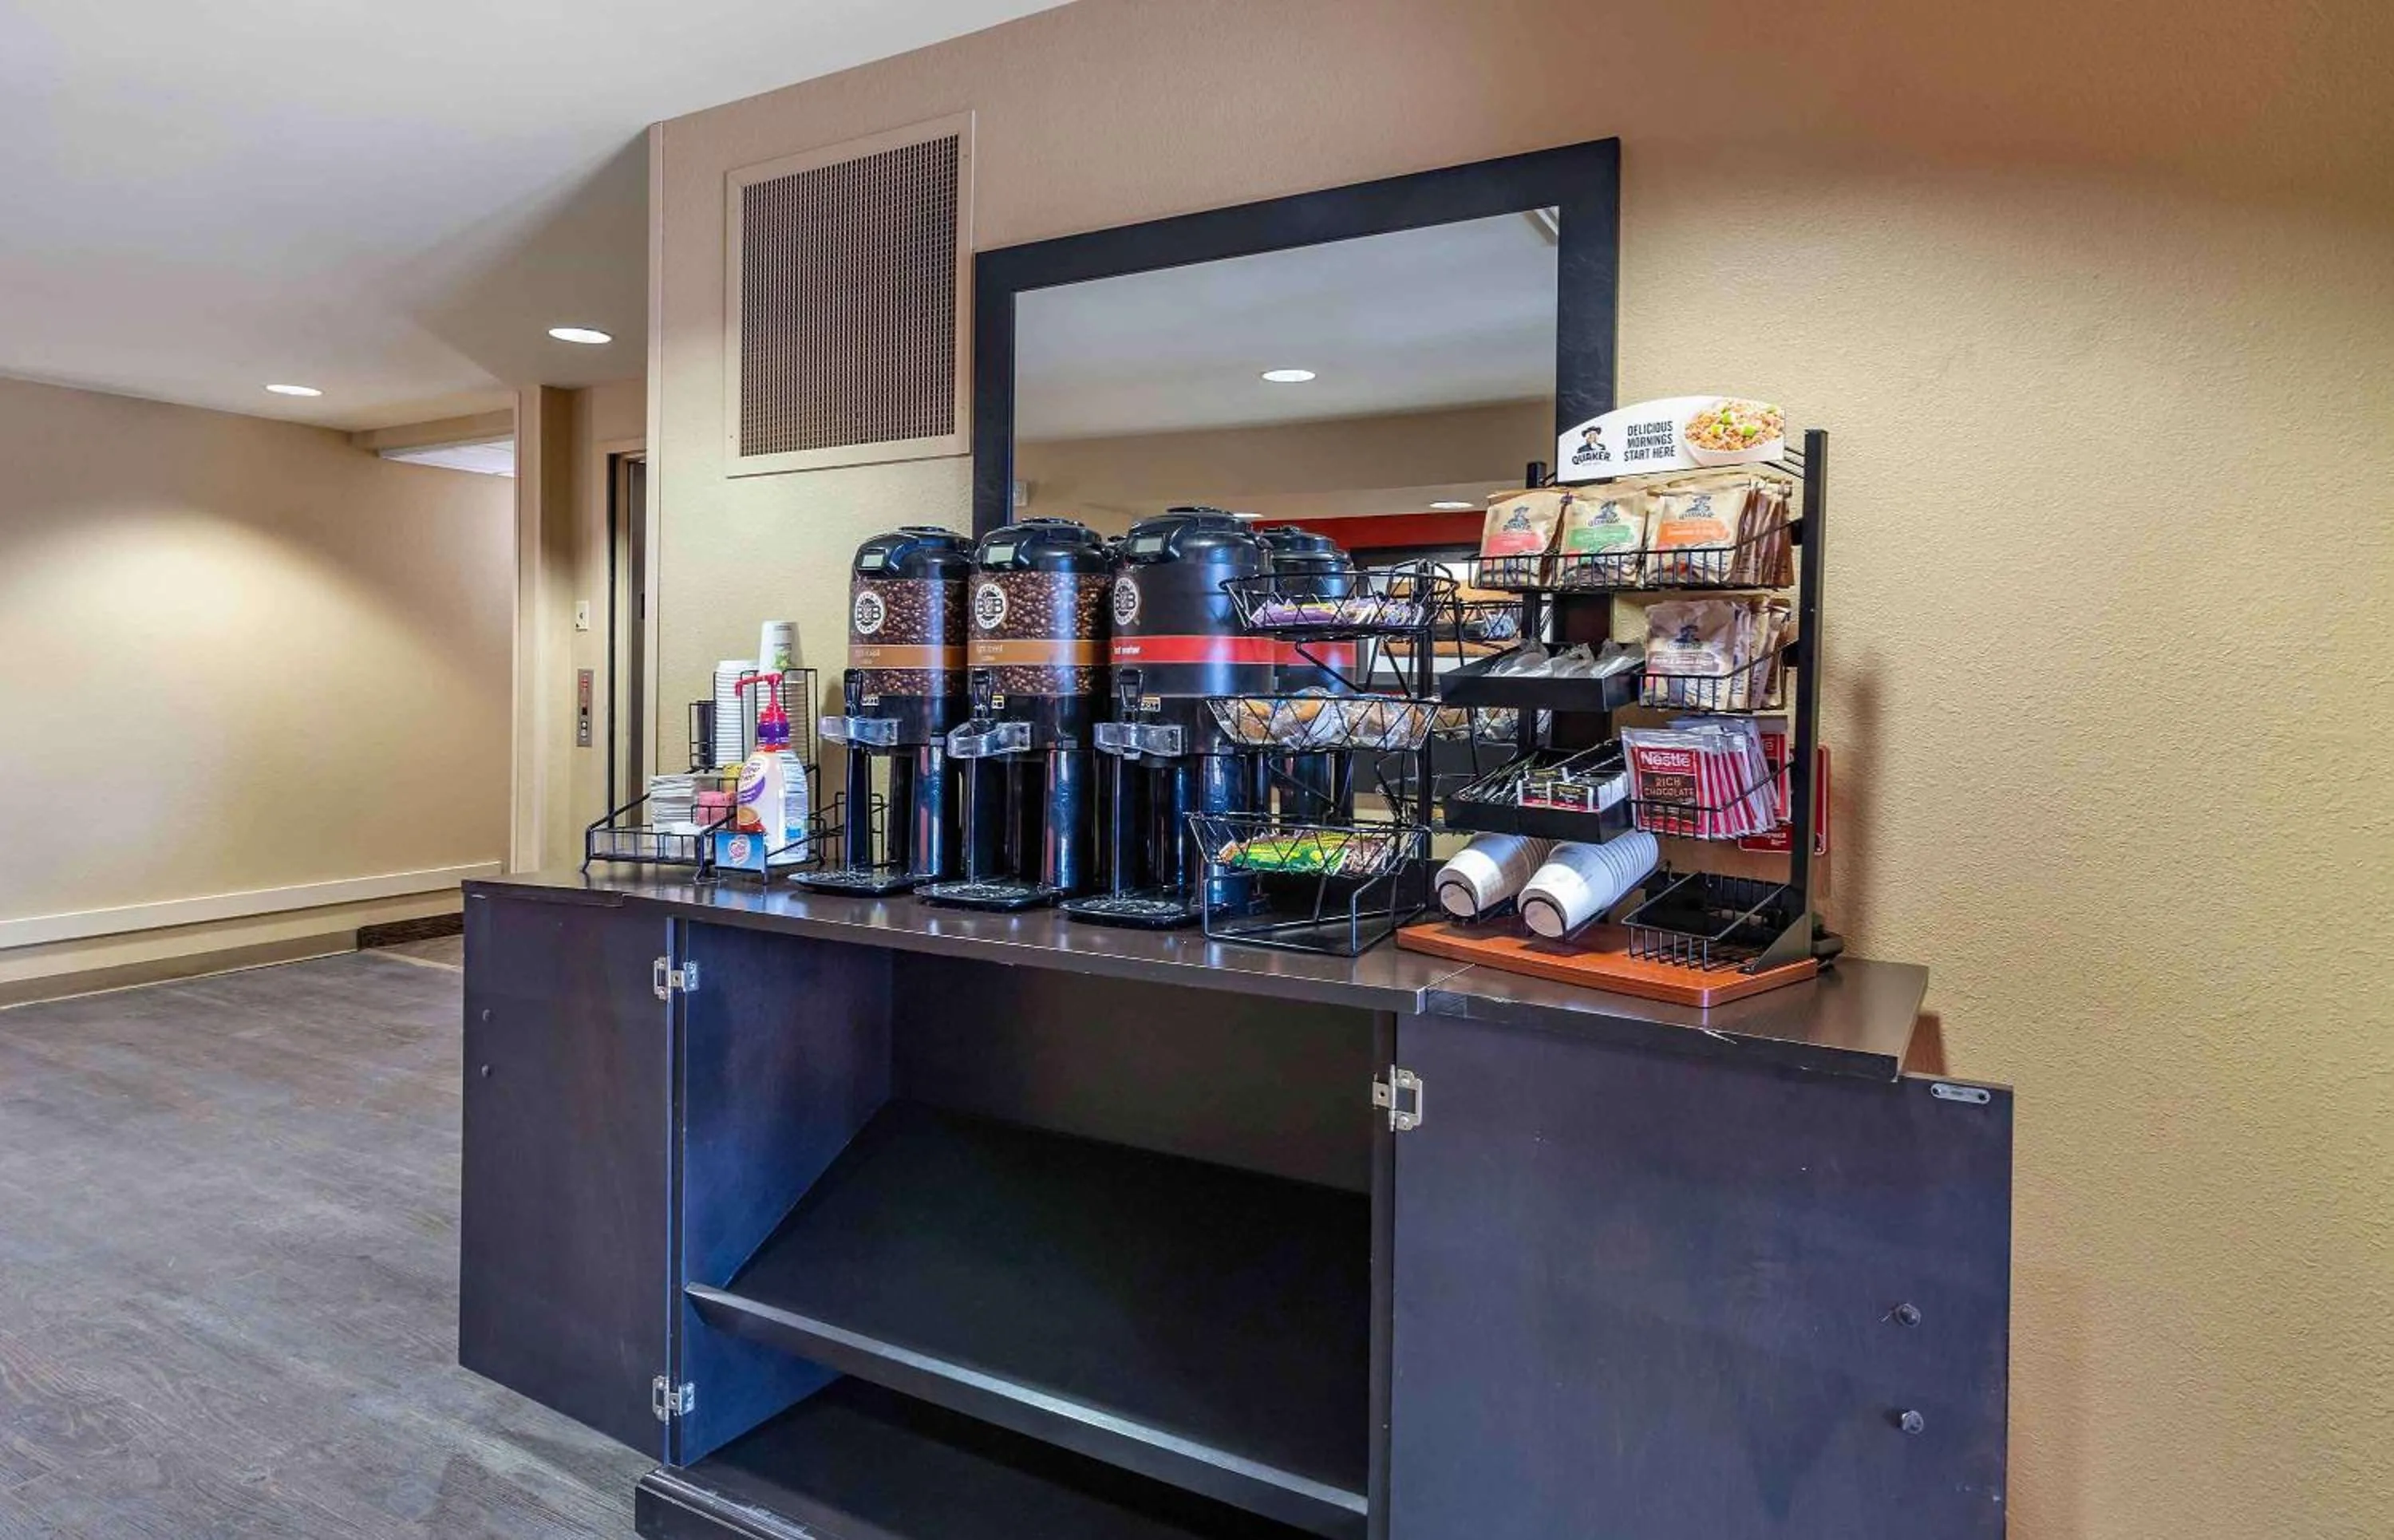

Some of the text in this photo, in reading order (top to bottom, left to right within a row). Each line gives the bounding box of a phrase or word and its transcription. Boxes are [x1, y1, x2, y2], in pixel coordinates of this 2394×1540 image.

[1627, 421, 1673, 436] DELICIOUS
[1627, 433, 1673, 448] MORNINGS
[1571, 451, 1612, 464] QUAKER
[1624, 444, 1676, 462] START HERE
[1654, 776, 1681, 788] RICH
[1644, 787, 1694, 797] CHOCOLATE
